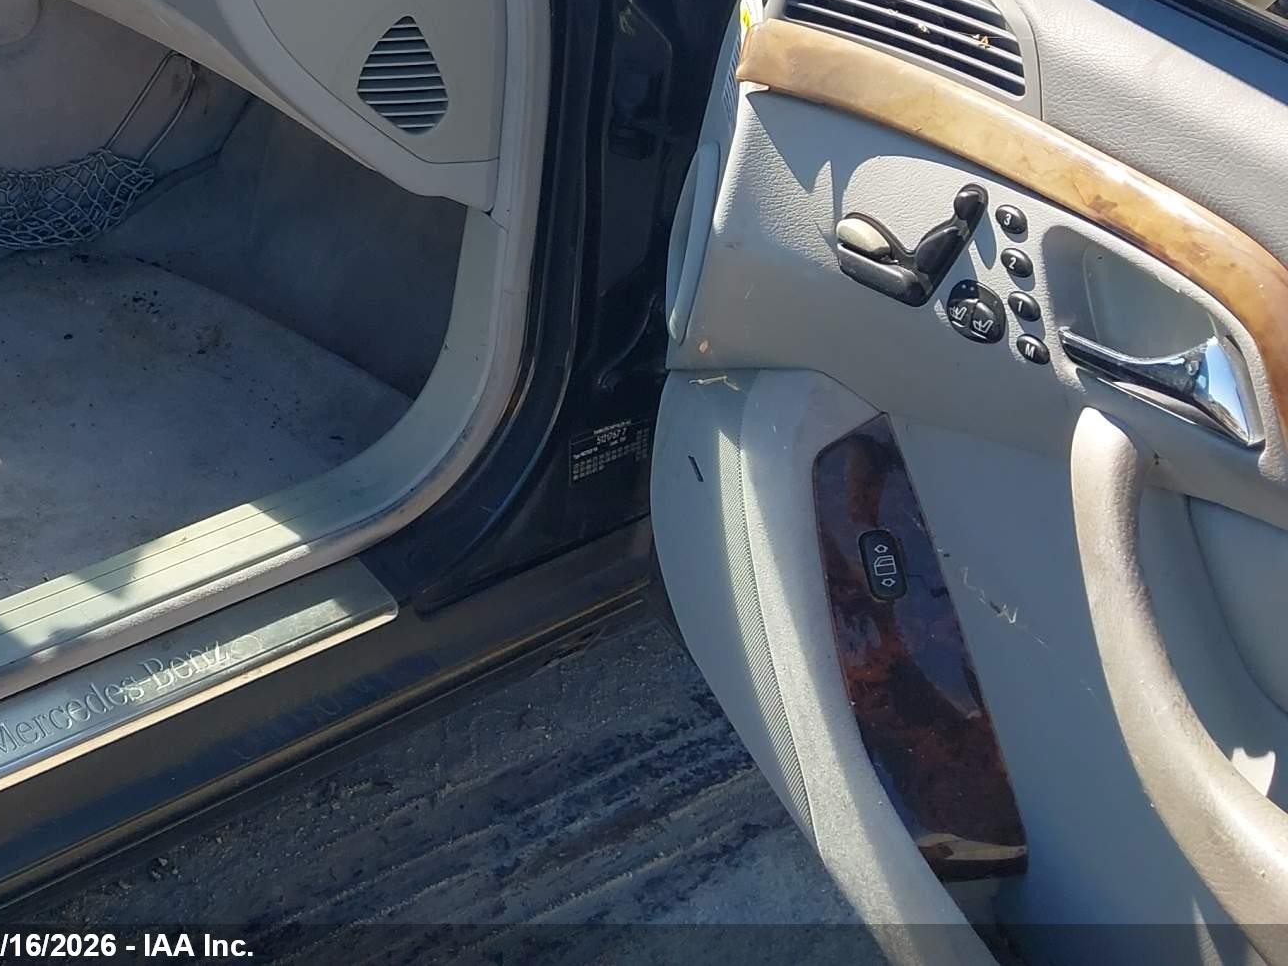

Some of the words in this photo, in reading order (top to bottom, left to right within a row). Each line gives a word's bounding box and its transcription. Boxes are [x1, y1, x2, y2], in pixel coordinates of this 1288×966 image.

[1003, 213, 1012, 226] 3
[1008, 257, 1017, 270] 2
[1017, 300, 1023, 311] 1
[1024, 343, 1035, 358] M
